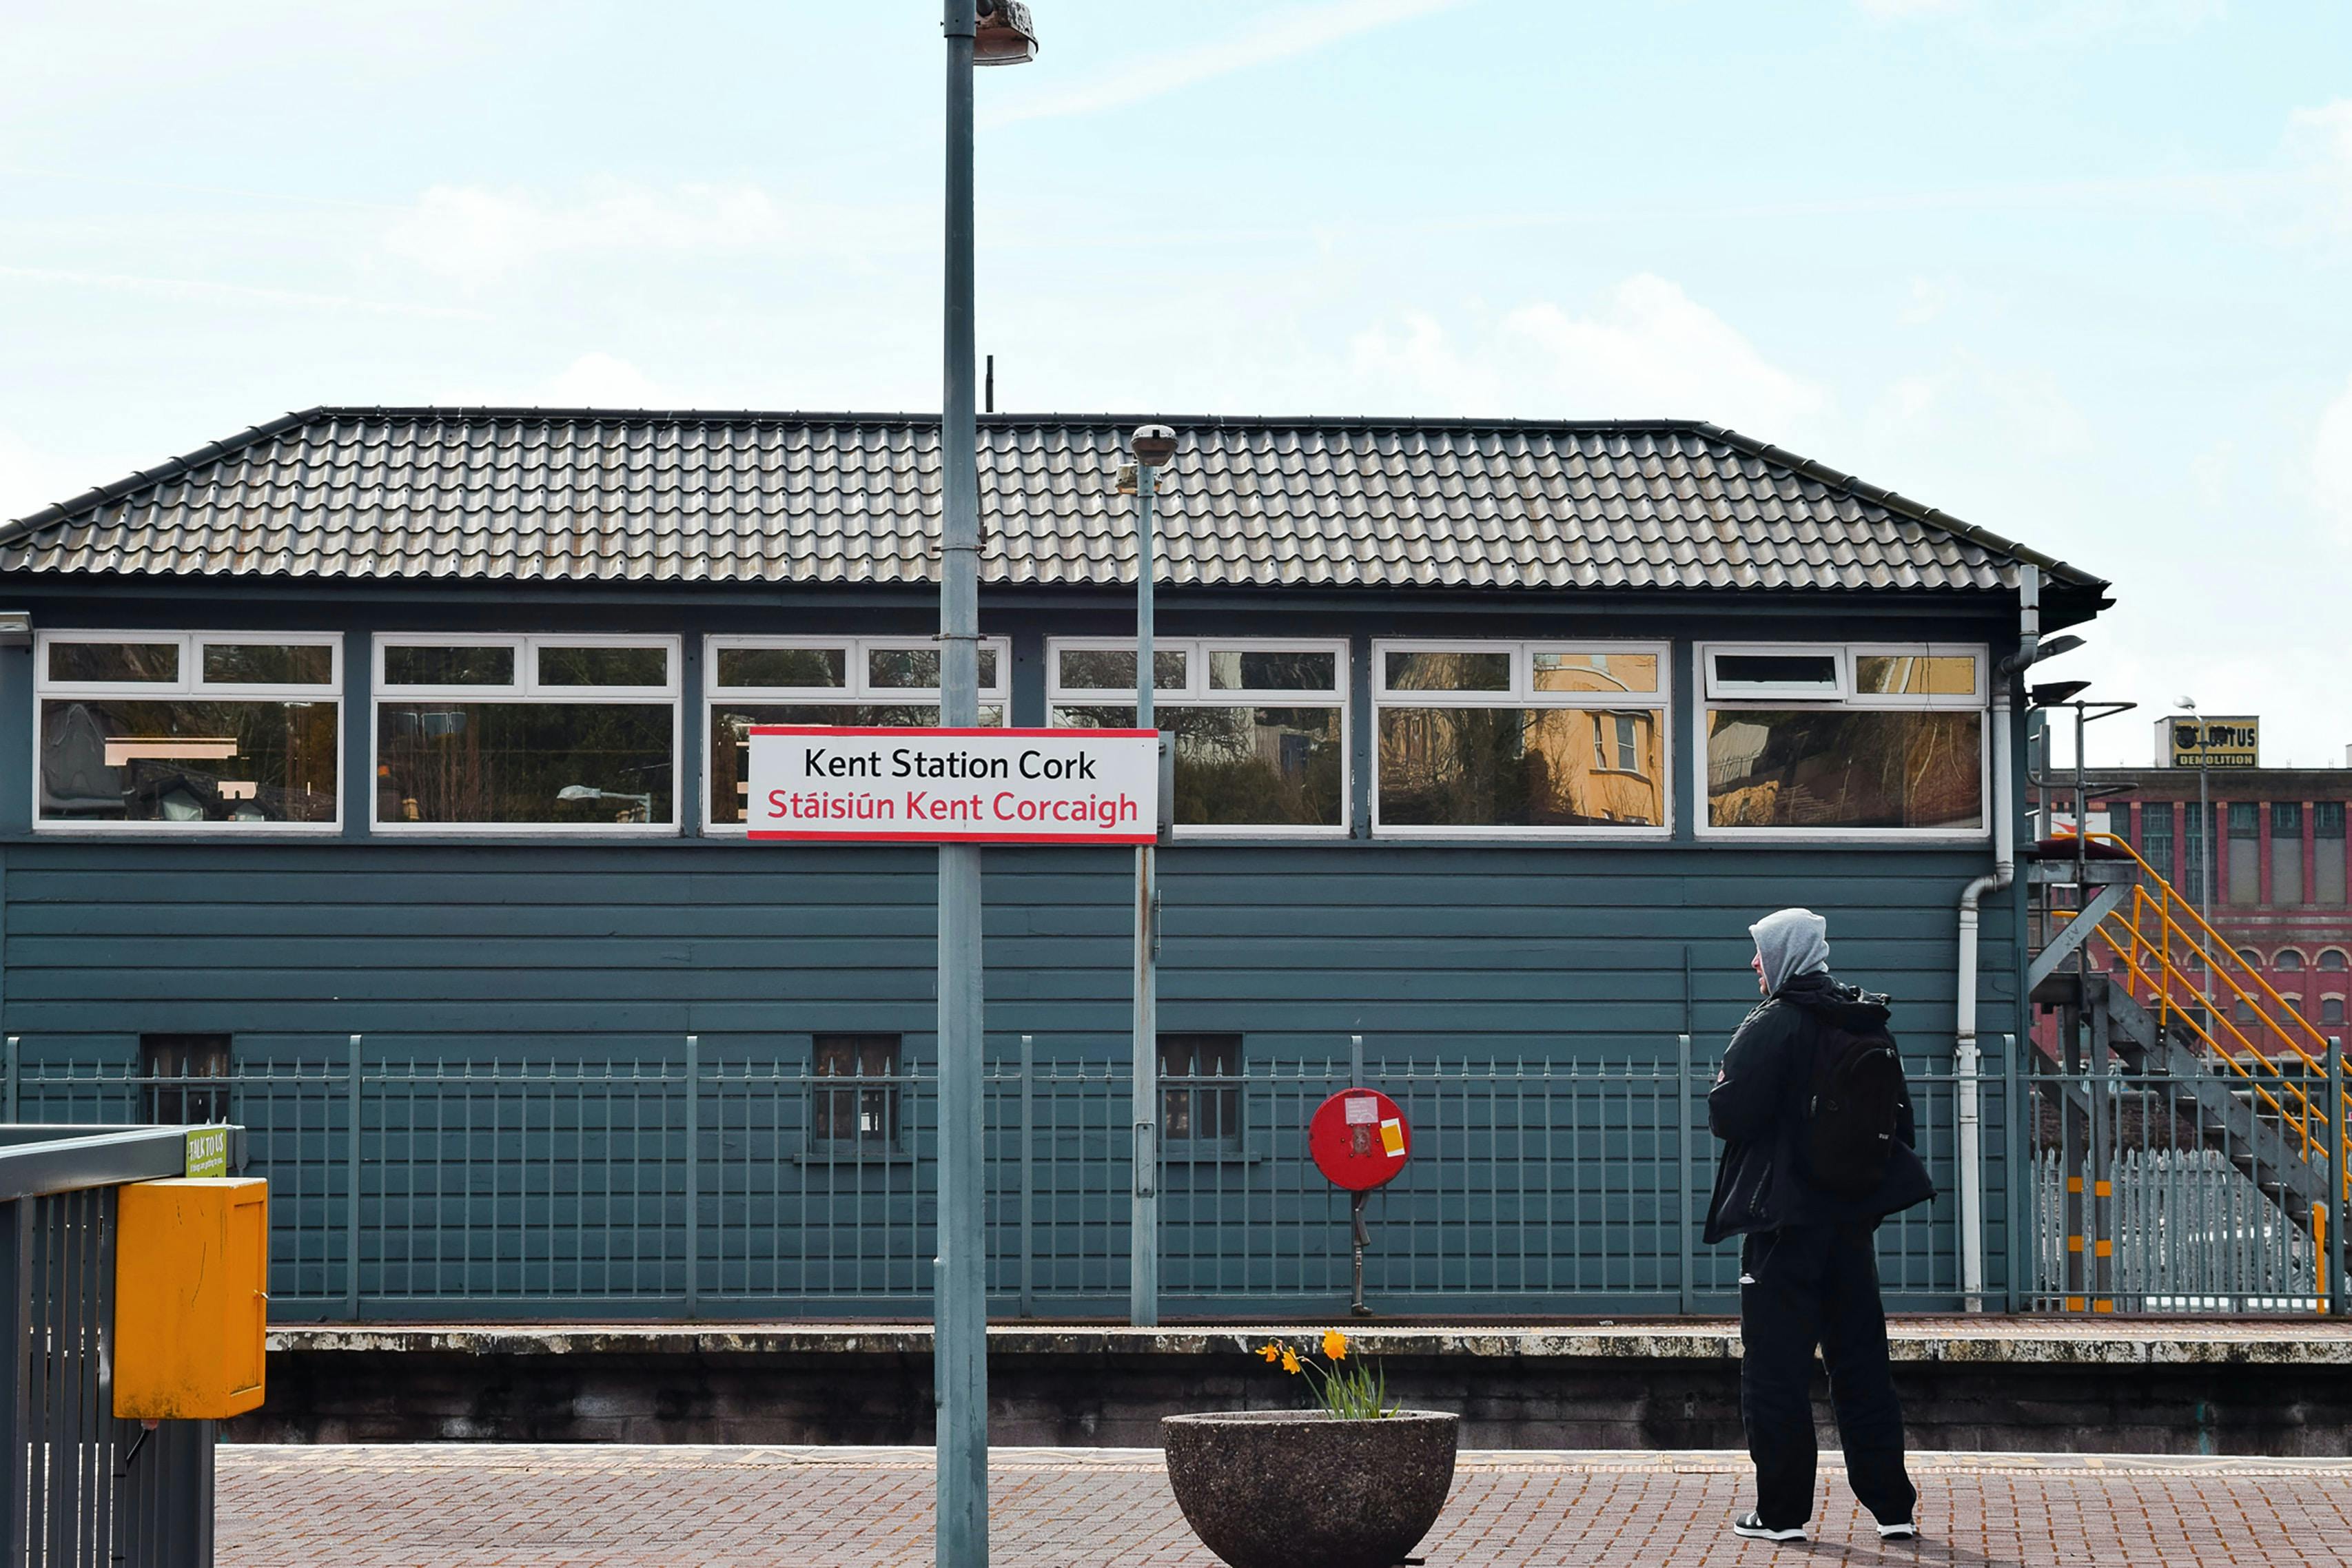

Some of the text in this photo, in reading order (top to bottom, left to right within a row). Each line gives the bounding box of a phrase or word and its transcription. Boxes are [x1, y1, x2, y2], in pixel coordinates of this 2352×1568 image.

[806, 748, 1096, 779] Kent Station Cork
[768, 790, 1138, 829] Stáisiún Kent Corcaigh
[190, 1133, 223, 1162] TALK TO US
